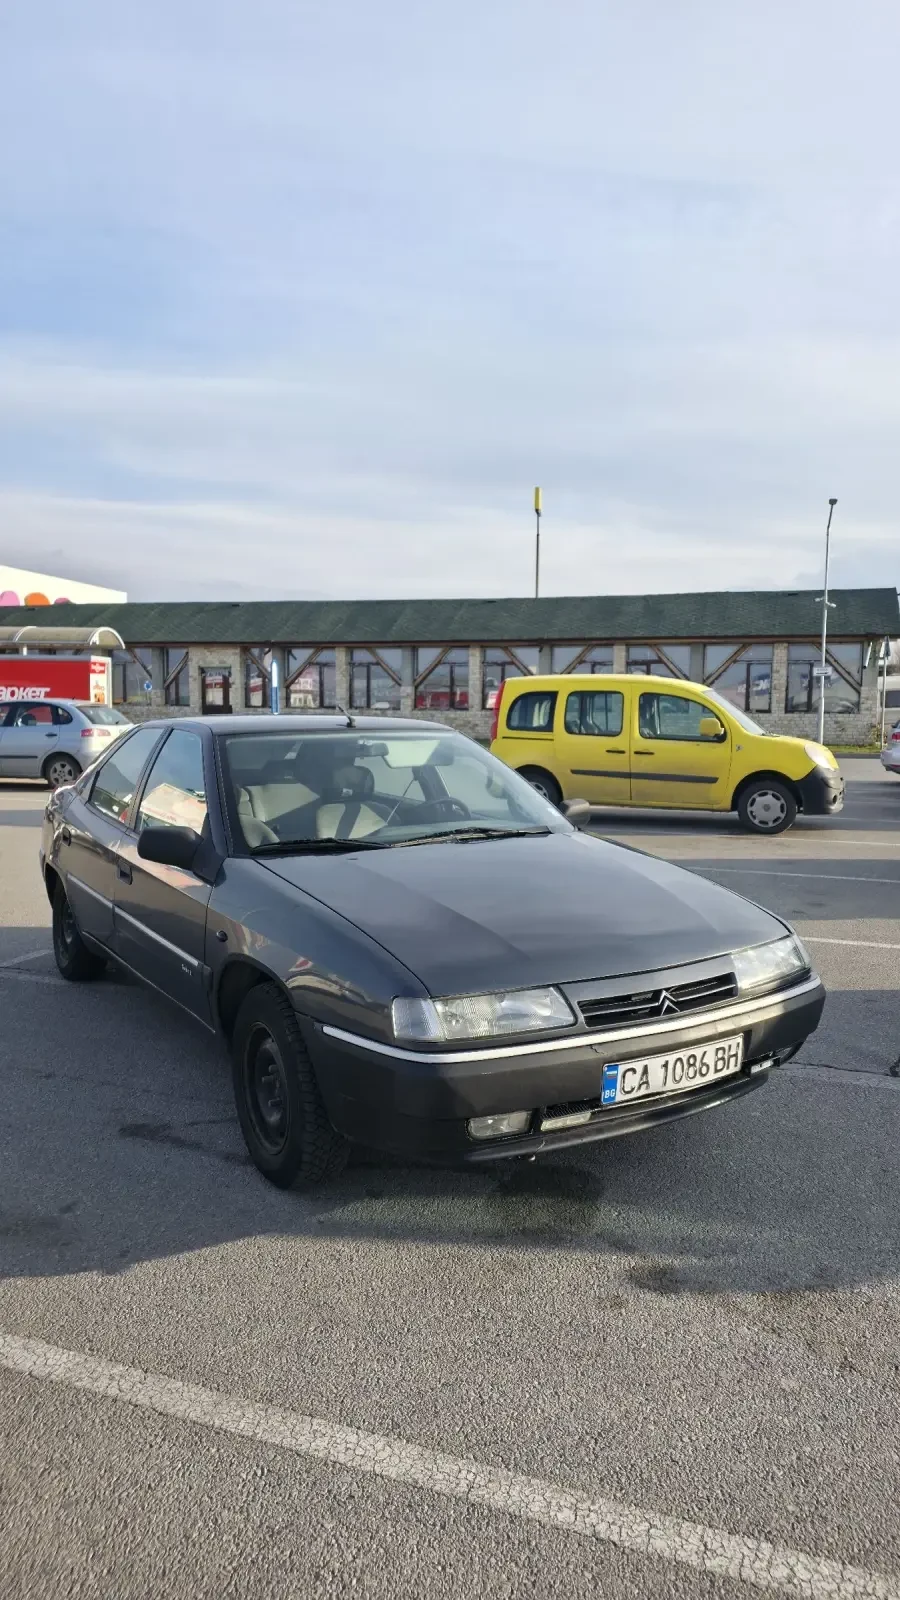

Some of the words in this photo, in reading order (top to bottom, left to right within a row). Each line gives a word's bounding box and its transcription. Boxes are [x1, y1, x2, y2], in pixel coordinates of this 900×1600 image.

[620, 1064, 650, 1095] CA
[661, 1051, 710, 1086] 1086
[713, 1042, 740, 1073] BH
[604, 1089, 615, 1099] BG
